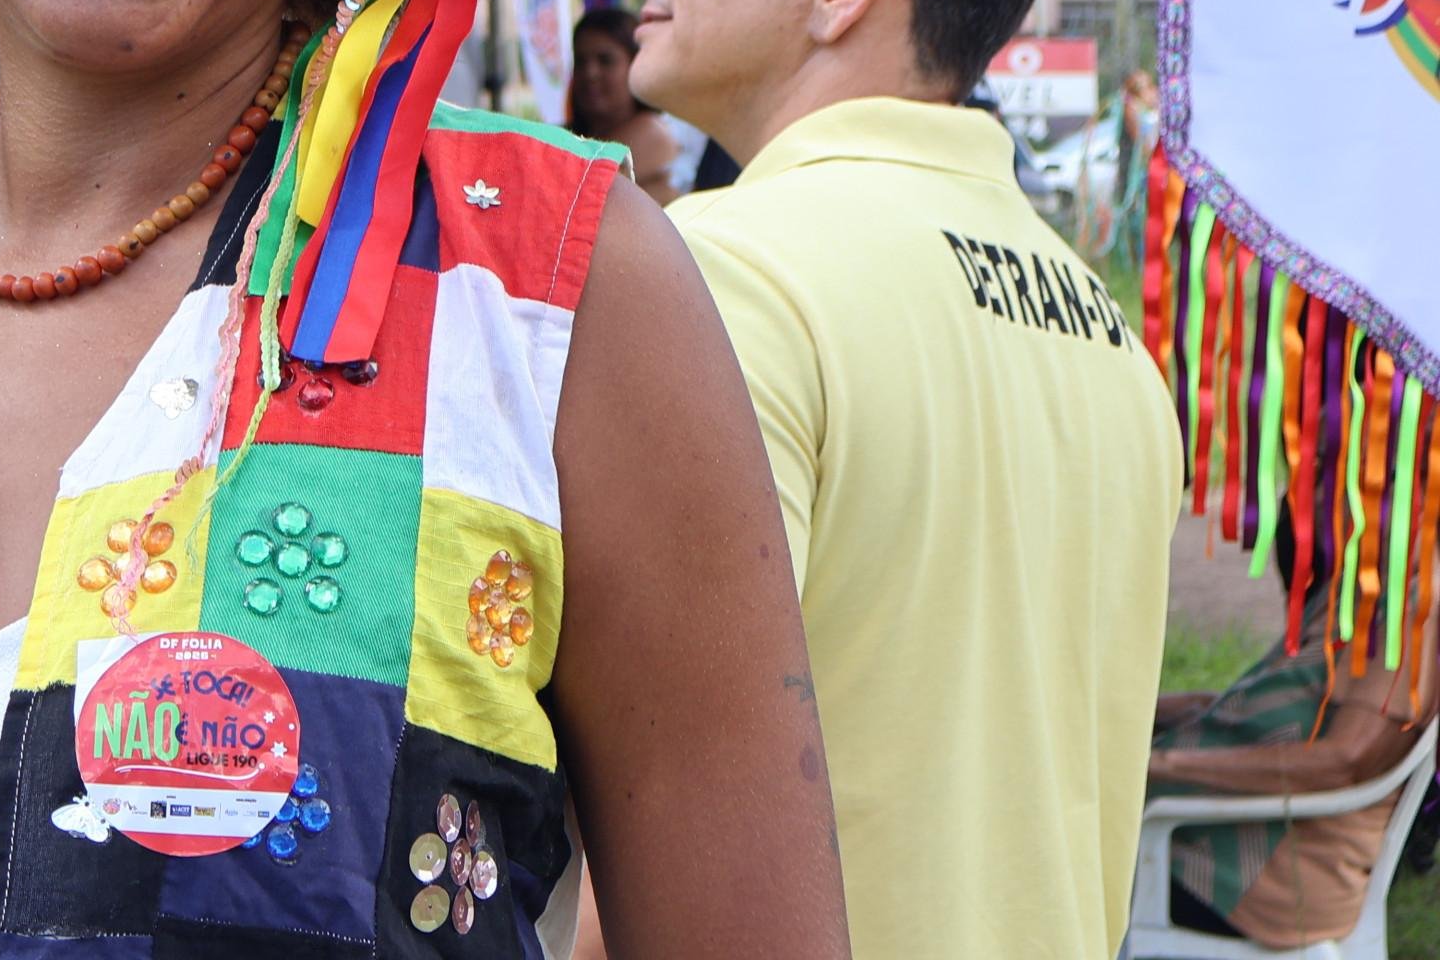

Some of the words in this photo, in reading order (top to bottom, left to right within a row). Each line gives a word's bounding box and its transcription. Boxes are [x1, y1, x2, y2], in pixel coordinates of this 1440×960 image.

[160, 638, 179, 650] DF
[181, 638, 223, 650] FOLIA
[180, 669, 255, 709] TOCA!
[93, 690, 180, 762] NÃO
[201, 715, 266, 750] NÃO
[232, 754, 259, 769] 190
